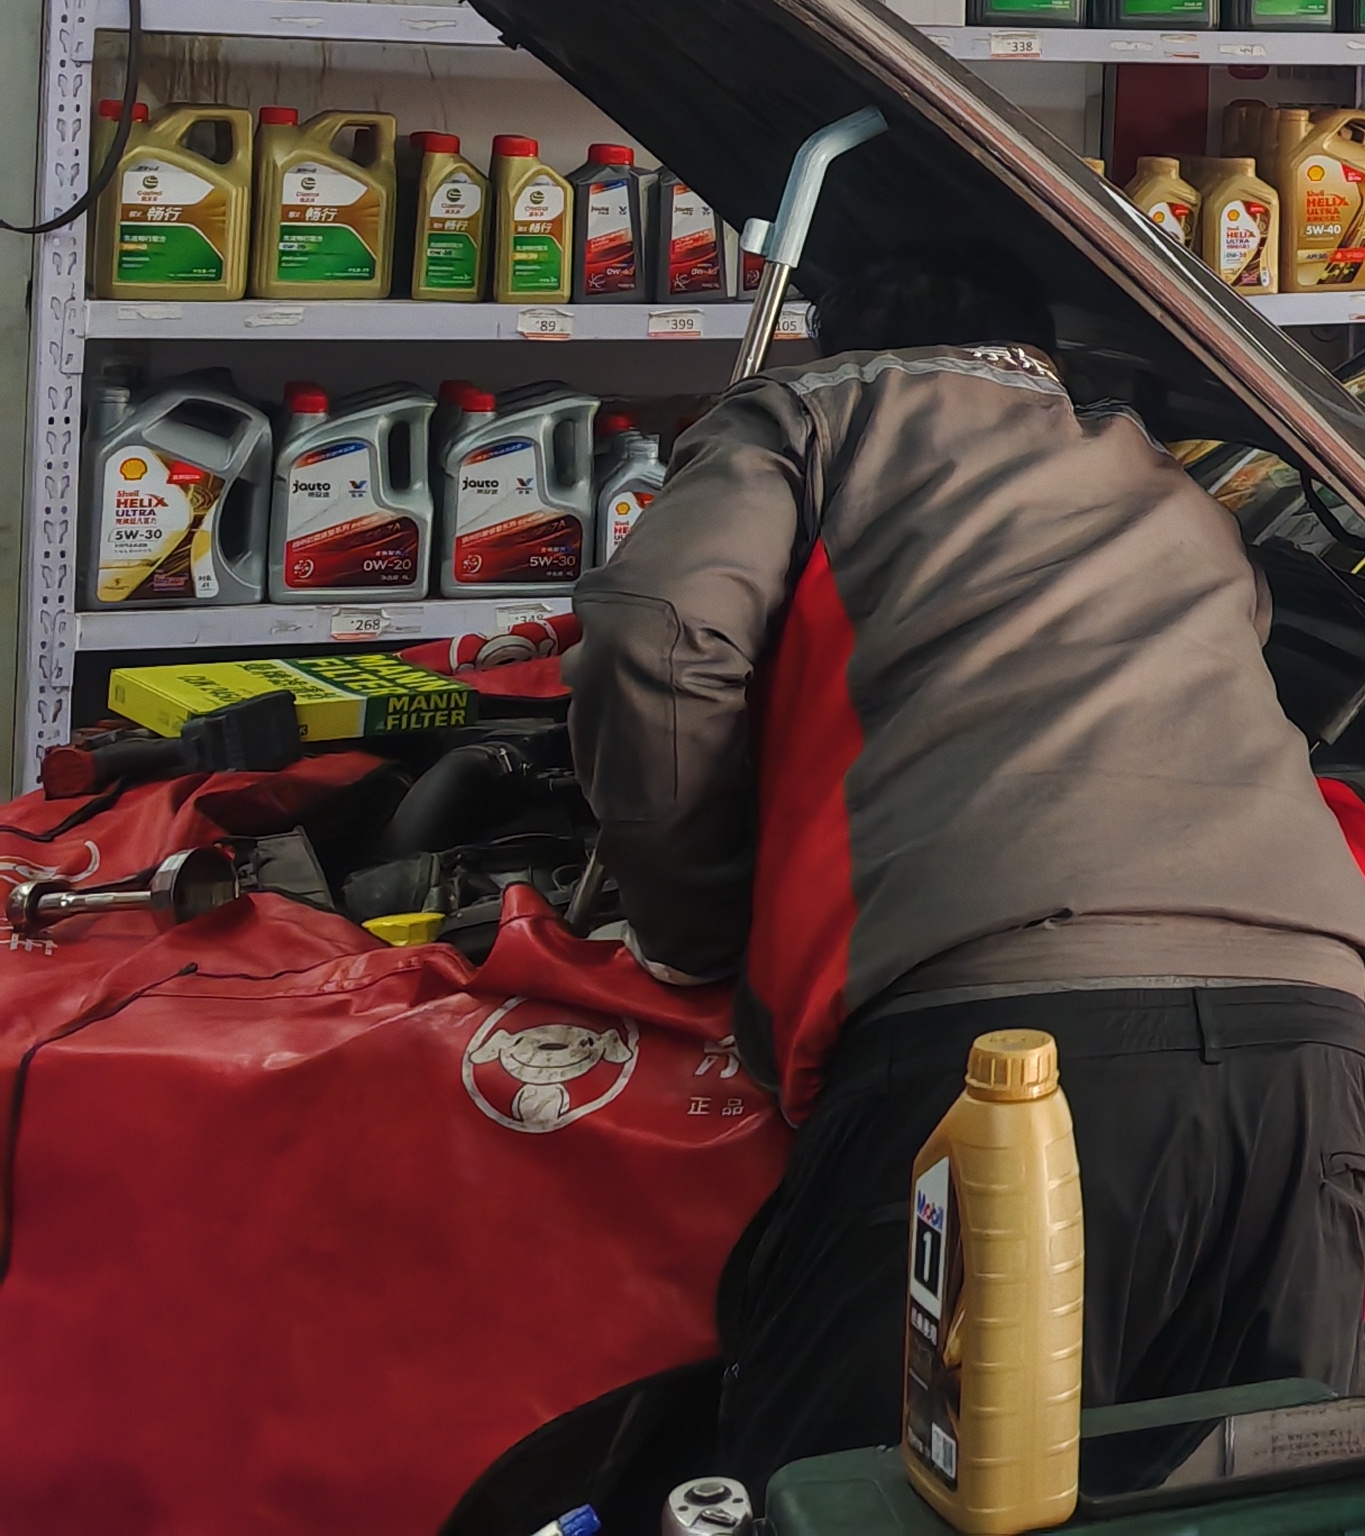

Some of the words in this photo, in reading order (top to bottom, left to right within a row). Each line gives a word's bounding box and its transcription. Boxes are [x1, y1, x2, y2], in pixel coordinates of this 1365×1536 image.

[1010, 40, 1034, 53] 338
[1306, 194, 1350, 208] HELIX
[146, 207, 183, 221] 畅行
[305, 207, 338, 221] 畅行
[1306, 207, 1341, 216] ULTRA
[444, 220, 469, 231] 畅行
[529, 223, 553, 234] 畅行
[1305, 224, 1342, 235] 5W-40
[1226, 230, 1257, 239] HELIX
[540, 321, 556, 332] 89
[671, 319, 694, 330] 399
[292, 480, 331, 494] jauto
[462, 477, 500, 490] jauto
[116, 493, 169, 508] HELIX
[115, 509, 157, 517] ULTRA
[114, 528, 163, 541] 5W-30
[363, 559, 412, 571] 0W-20
[529, 554, 576, 567] 5W-30
[354, 619, 381, 631] 268
[387, 692, 468, 713] MANN
[385, 712, 466, 731] FILTER
[923, 1231, 933, 1282] 1
